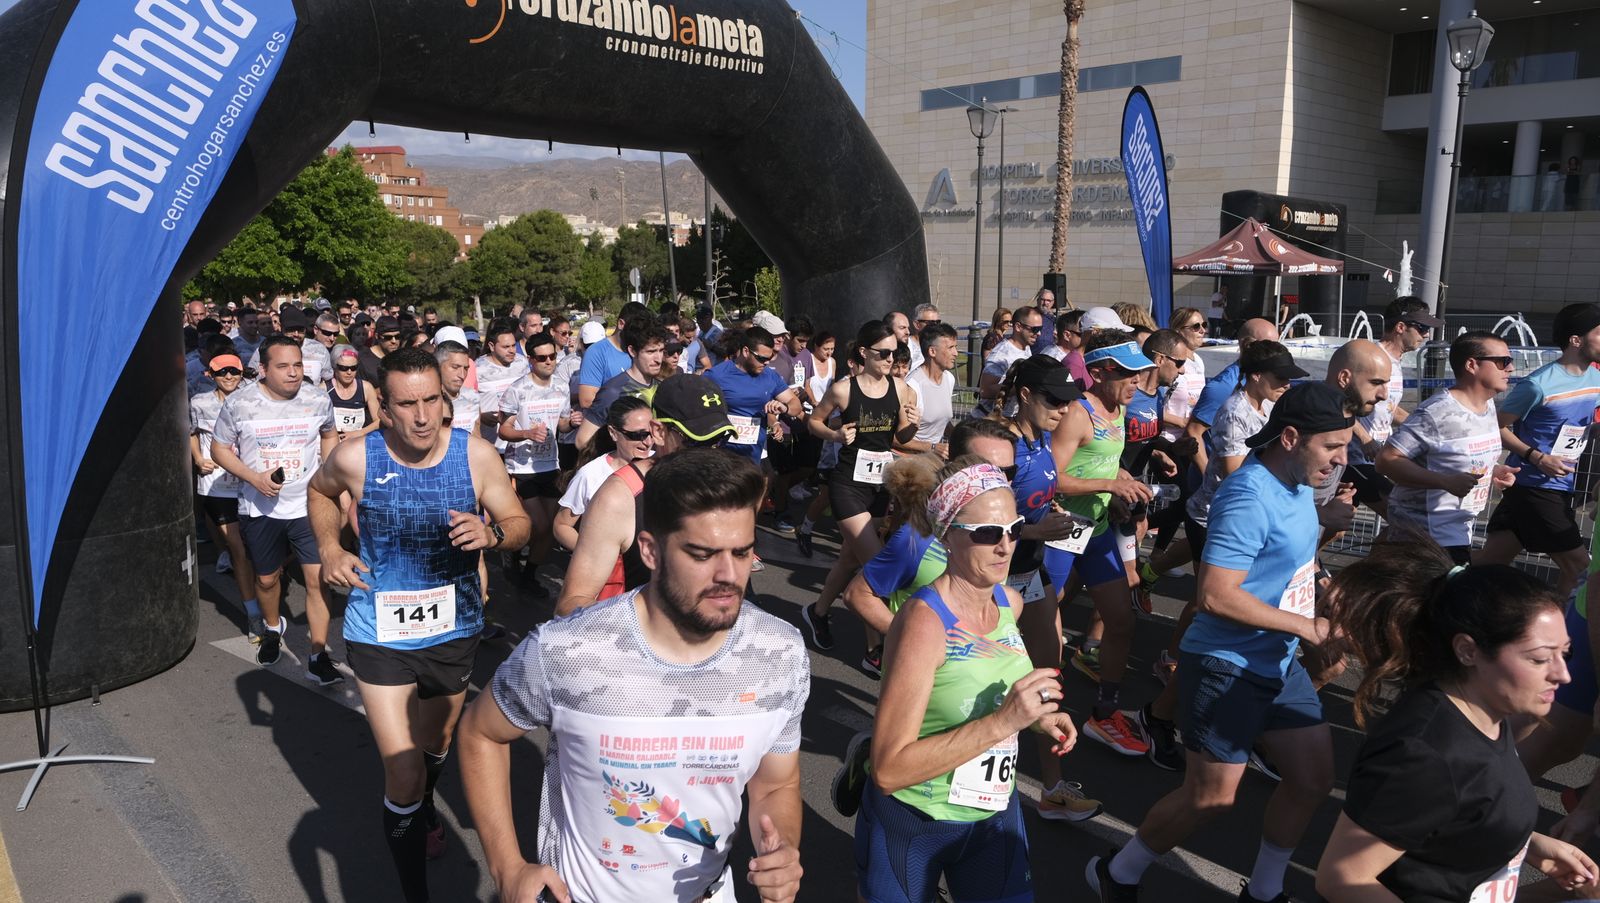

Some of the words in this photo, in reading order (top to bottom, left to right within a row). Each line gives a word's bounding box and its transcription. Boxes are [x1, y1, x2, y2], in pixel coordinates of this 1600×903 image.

[605, 36, 702, 65] cronometraje
[704, 51, 765, 75] deportivo
[160, 29, 287, 232] centrohogarsanchez.es
[343, 416, 356, 424] 51
[737, 425, 757, 436] 027
[263, 459, 300, 470] 1139
[393, 603, 438, 623] 141
[600, 734, 609, 748] II
[614, 736, 678, 751] CARRERA
[681, 736, 706, 750] SIN
[709, 735, 744, 750] HUMO
[610, 760, 639, 769] MUNDIAL
